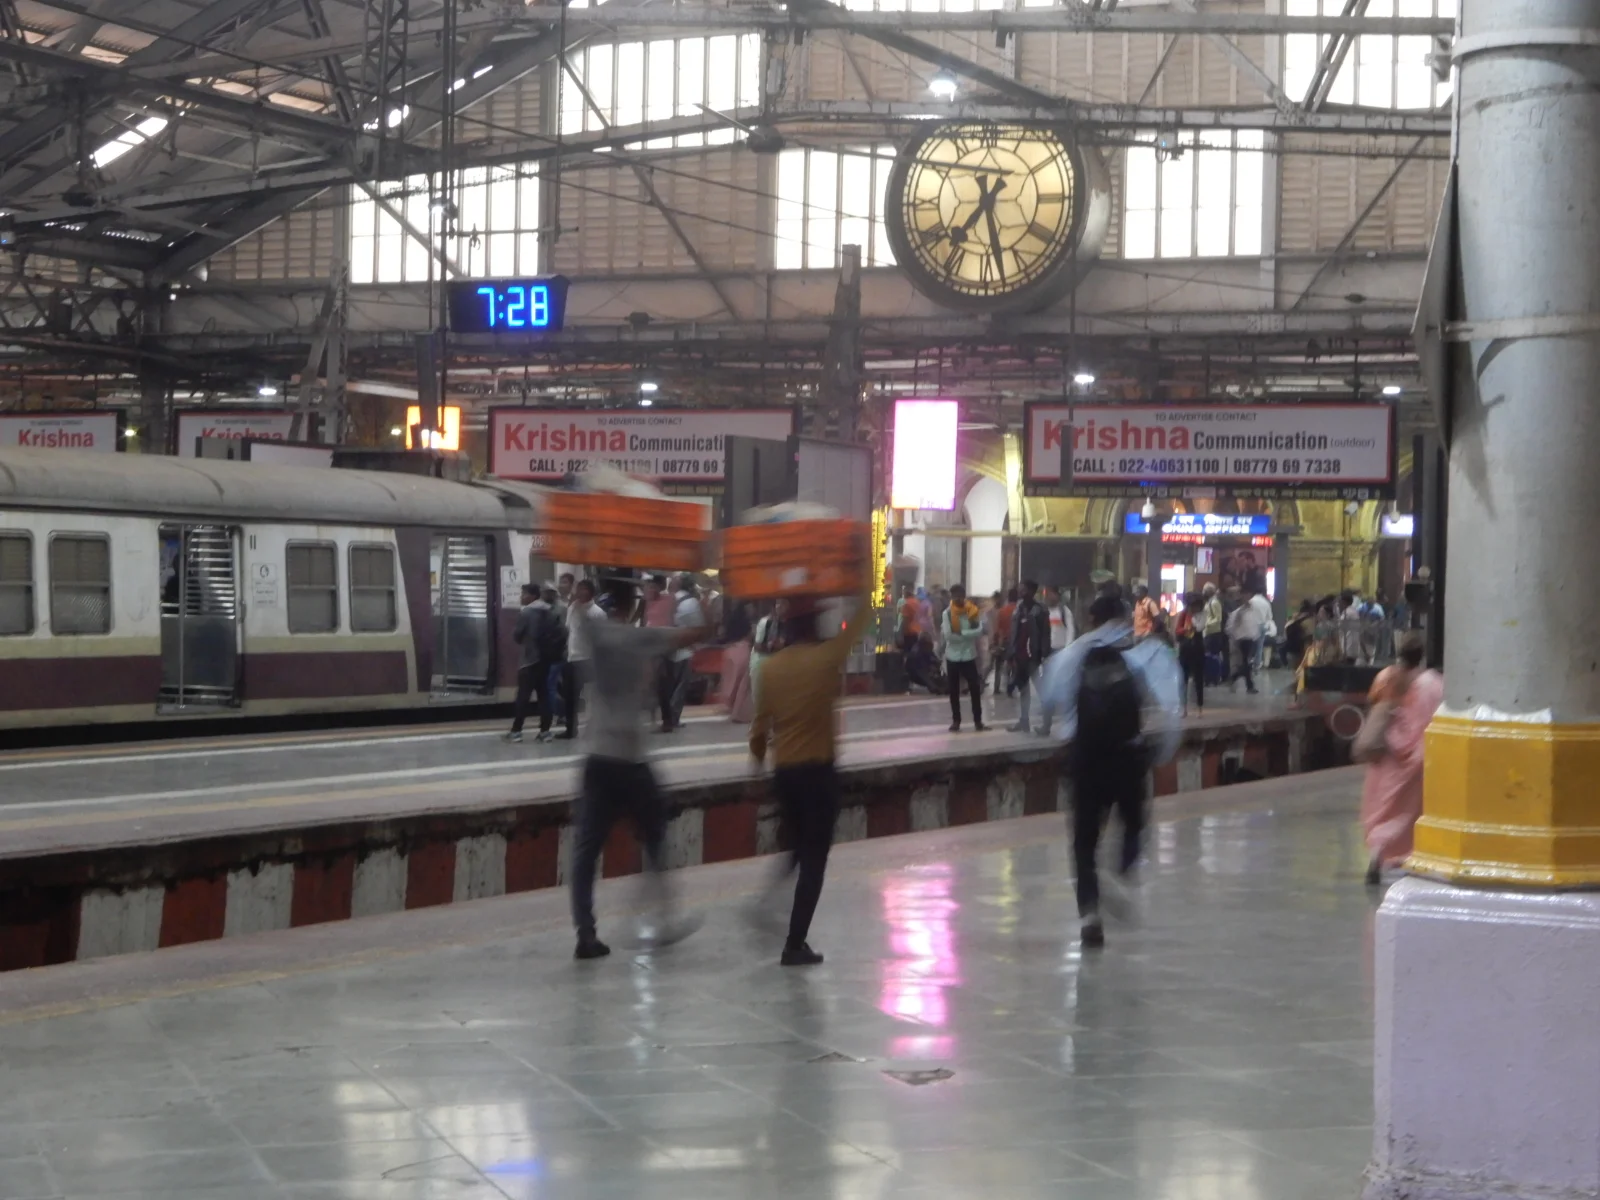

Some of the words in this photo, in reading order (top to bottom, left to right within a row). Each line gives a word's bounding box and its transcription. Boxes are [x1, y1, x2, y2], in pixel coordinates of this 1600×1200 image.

[476, 286, 548, 327] 7:28
[647, 417, 683, 426] CONTACT
[1155, 412, 1167, 421] TO
[1168, 412, 1214, 421] ADVERTISE
[1215, 412, 1258, 421] CONTACT
[18, 428, 95, 448] Krishna
[504, 423, 627, 452] Krishna
[1043, 419, 1190, 451] Krishna
[1193, 431, 1328, 450] Communication
[1330, 437, 1376, 449] (outdoor)
[529, 459, 557, 472] CALL
[662, 460, 700, 474] 08779
[703, 460, 719, 473] 69
[1073, 458, 1106, 473] CALL
[1119, 458, 1220, 474] 022-40631100
[1233, 458, 1278, 474] 08779
[1282, 458, 1300, 474] 69
[1305, 458, 1341, 474] 7338
